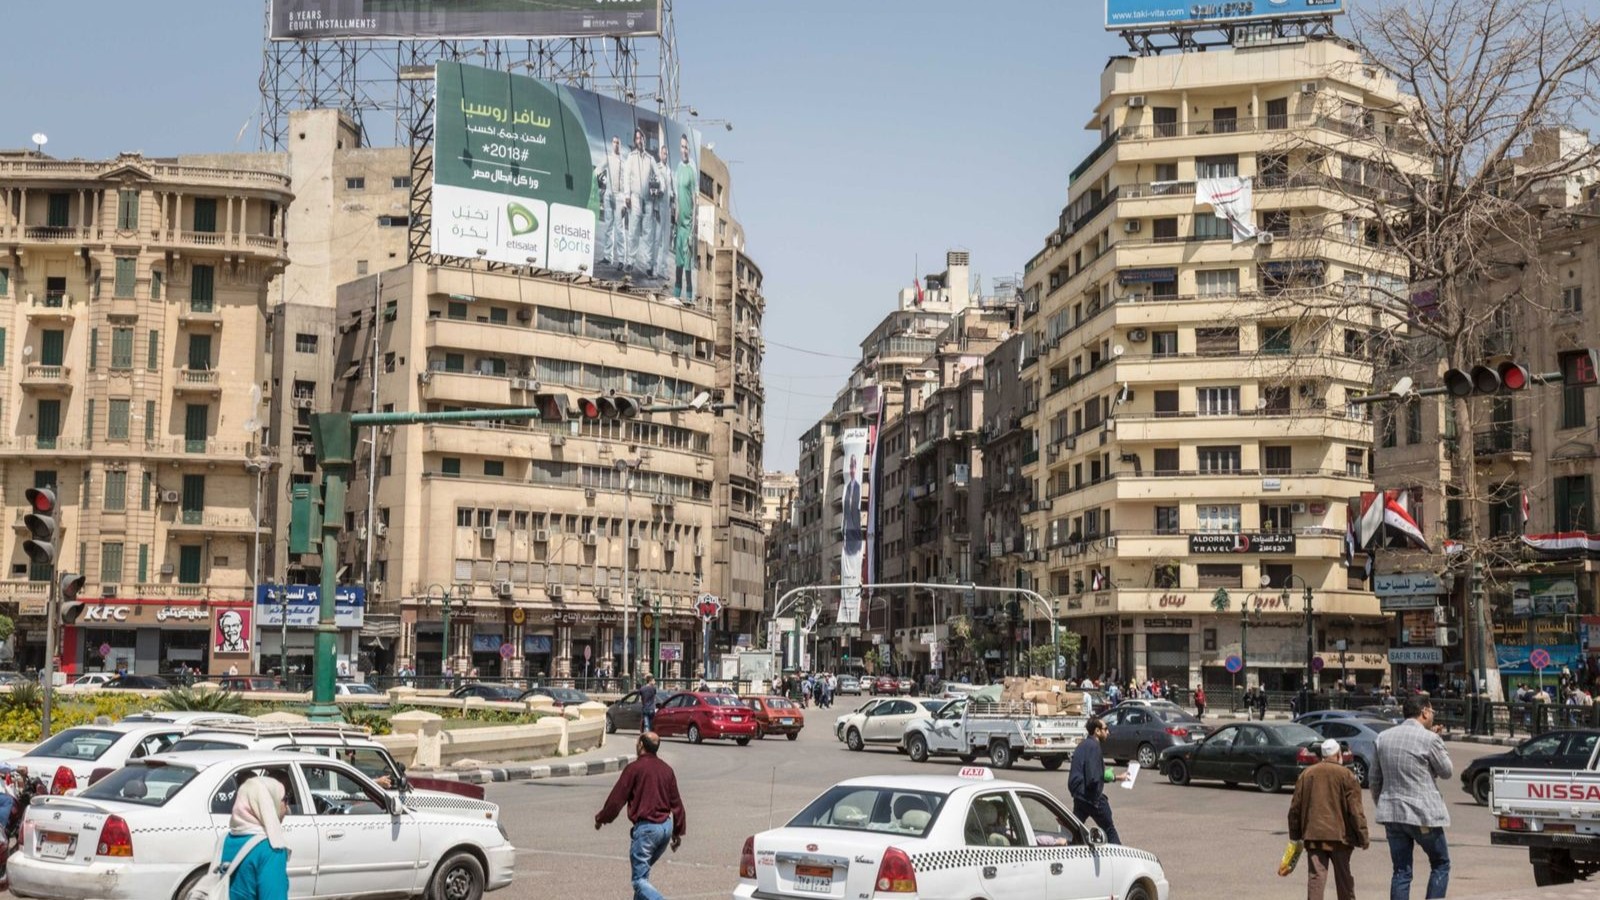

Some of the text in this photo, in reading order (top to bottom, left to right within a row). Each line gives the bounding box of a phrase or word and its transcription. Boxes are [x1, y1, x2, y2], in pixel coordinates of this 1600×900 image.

[289, 10, 322, 21] 8 YEARS
[1112, 8, 1185, 20] www.taki-vita.com
[289, 19, 377, 31] EQUAL INSTALLMENTS
[461, 98, 551, 128] سافر روسيا
[471, 169, 490, 180] مصر
[513, 174, 528, 187] كل
[554, 223, 591, 240] etisalat
[506, 239, 538, 252] etisalat
[553, 236, 591, 254] sports
[1192, 535, 1231, 543] ALDORRA
[1376, 575, 1437, 593] سفير للسياحة
[1158, 594, 1187, 608] لبنان
[84, 606, 130, 621] KFC
[1390, 651, 1410, 661] SAFIR
[1412, 651, 1440, 660] TRAVEL
[961, 768, 985, 776] TAXI
